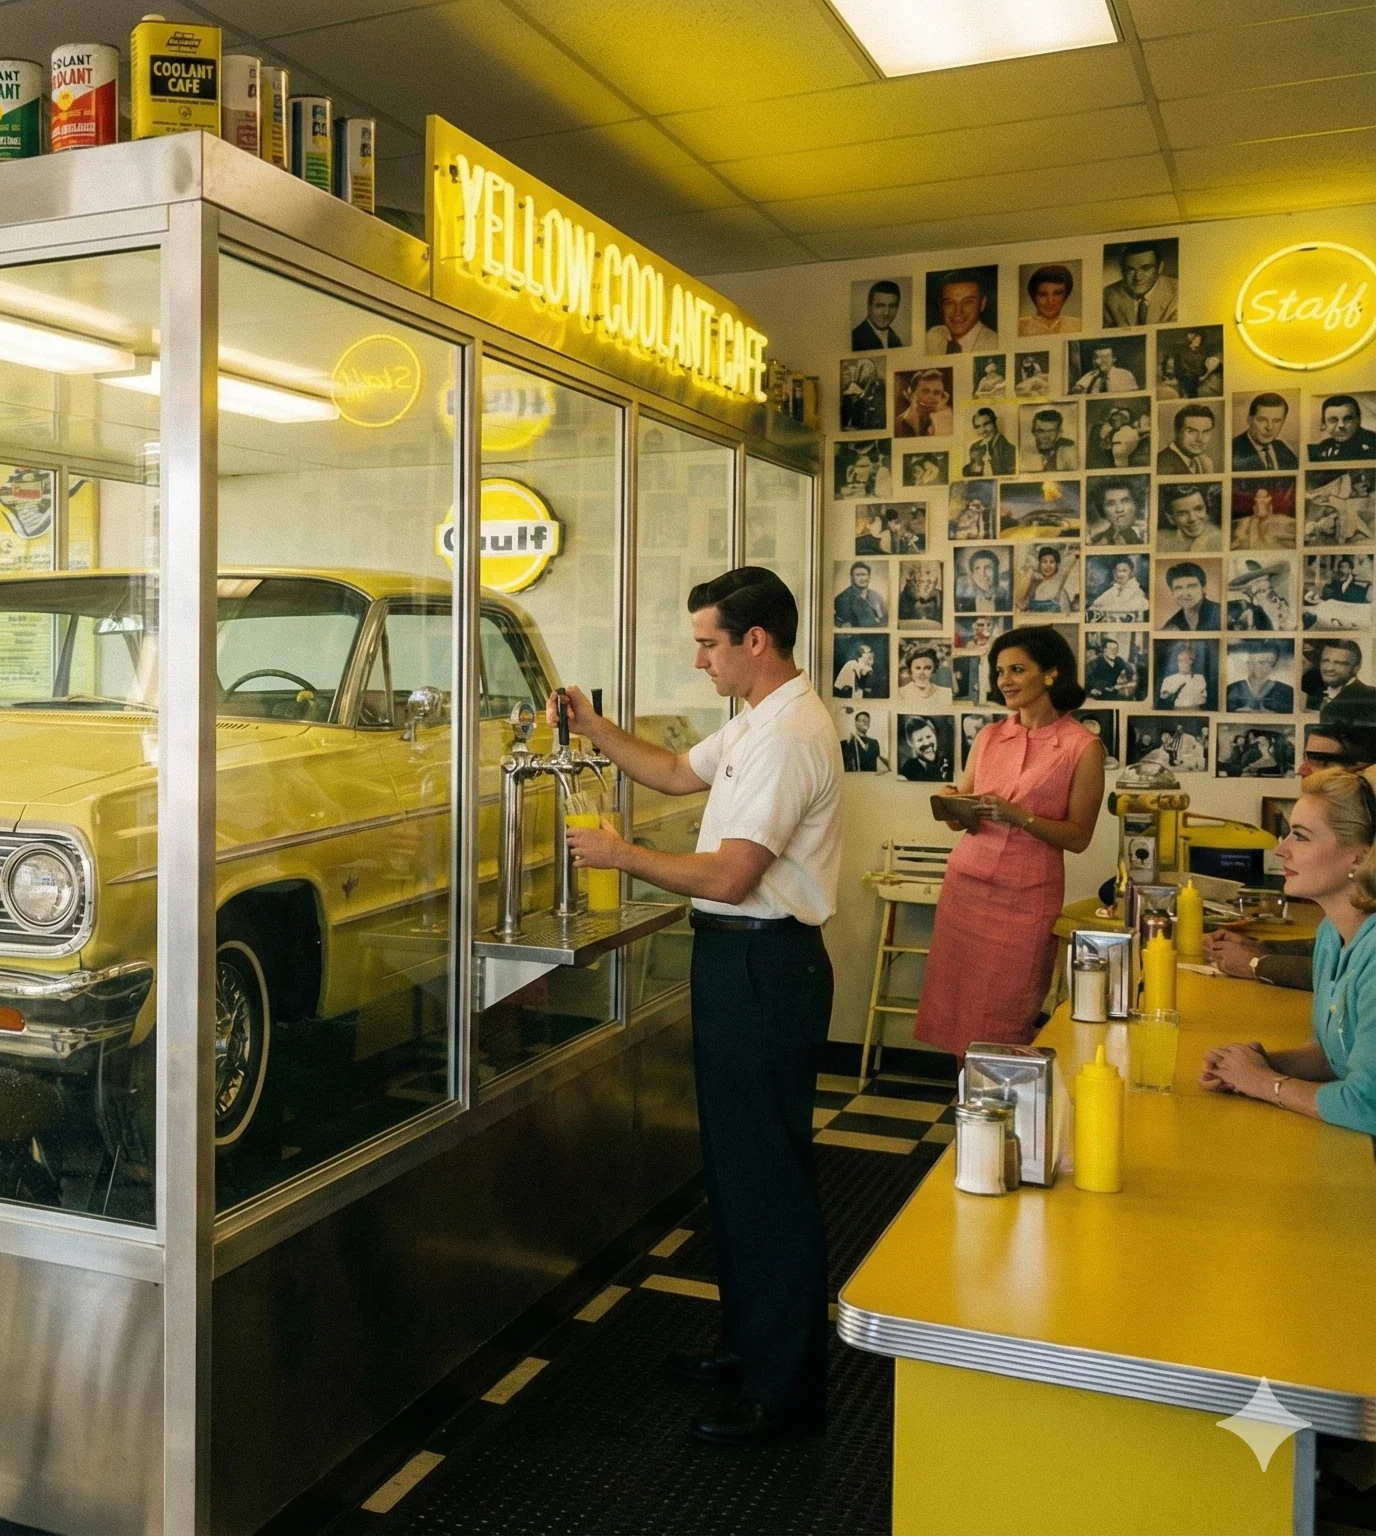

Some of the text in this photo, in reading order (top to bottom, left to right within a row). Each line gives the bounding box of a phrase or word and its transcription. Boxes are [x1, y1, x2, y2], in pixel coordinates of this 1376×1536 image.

[153, 61, 213, 79] COOLANT
[168, 78, 200, 94] CAFE
[456, 154, 768, 403] YELLOW COOLANT CAFE
[1246, 281, 1368, 331] Staff
